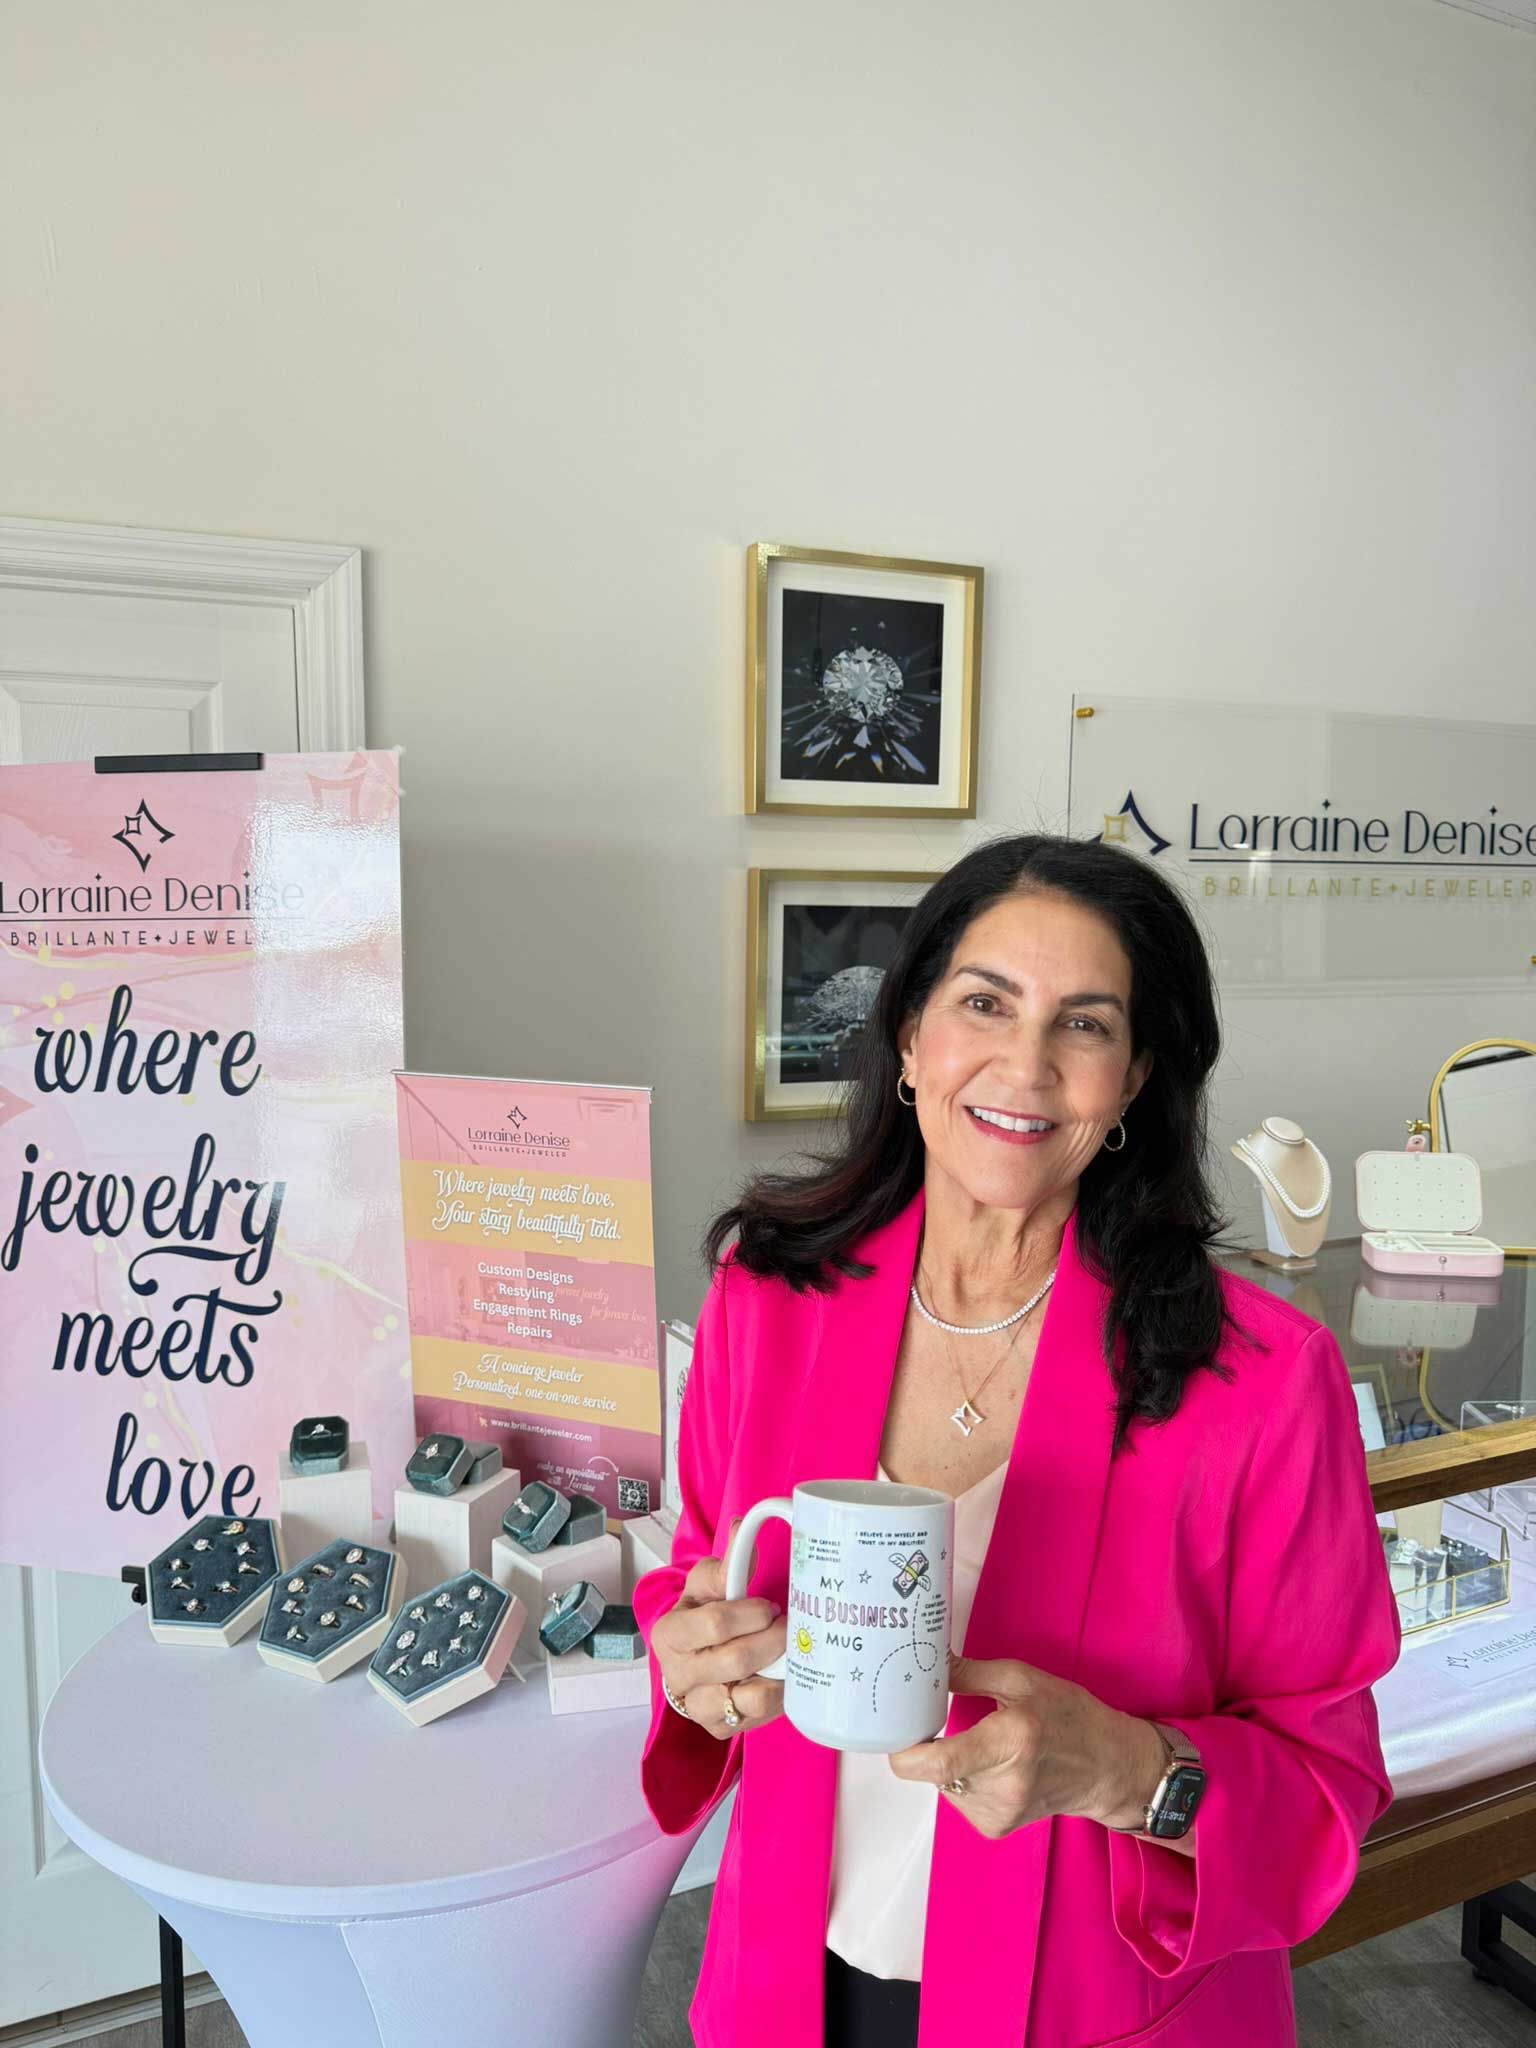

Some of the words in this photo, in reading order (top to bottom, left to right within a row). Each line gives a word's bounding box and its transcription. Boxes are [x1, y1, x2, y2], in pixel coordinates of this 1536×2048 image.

[1190, 798, 1389, 853] Lorraine
[0, 873, 152, 914] Lorraine
[164, 870, 305, 912] Denise
[34, 984, 262, 1097] where
[468, 1127, 522, 1143] Lorraine
[524, 1131, 571, 1147] Denise
[433, 1169, 485, 1198] Where
[486, 1177, 535, 1208] jewelry
[540, 1183, 583, 1204] meets
[581, 1184, 616, 1208] love.
[1, 1133, 287, 1296] jewelry
[432, 1200, 476, 1231] Your
[479, 1206, 512, 1237] story
[516, 1208, 586, 1244] beautifully
[586, 1217, 622, 1240] told.
[478, 1262, 523, 1278] Custom
[526, 1267, 574, 1286] Designs
[498, 1283, 555, 1304] Restyling
[473, 1299, 547, 1319] Engagement
[550, 1308, 583, 1326] Rings
[507, 1322, 553, 1339] Repairs
[52, 1287, 283, 1388] meets
[476, 1353, 502, 1375] A
[501, 1362, 548, 1383] concierge
[547, 1366, 584, 1384] jeweler
[452, 1370, 522, 1400] Personalized,
[525, 1388, 580, 1406] one-on-one
[582, 1395, 617, 1412] service
[490, 1418, 593, 1442] www.brillantejeweler.com
[106, 1412, 261, 1520] love
[820, 1575, 844, 1592] MY
[790, 1580, 822, 1619] SMALL
[825, 1596, 909, 1629] BUSINESS
[826, 1631, 863, 1652] MUG
